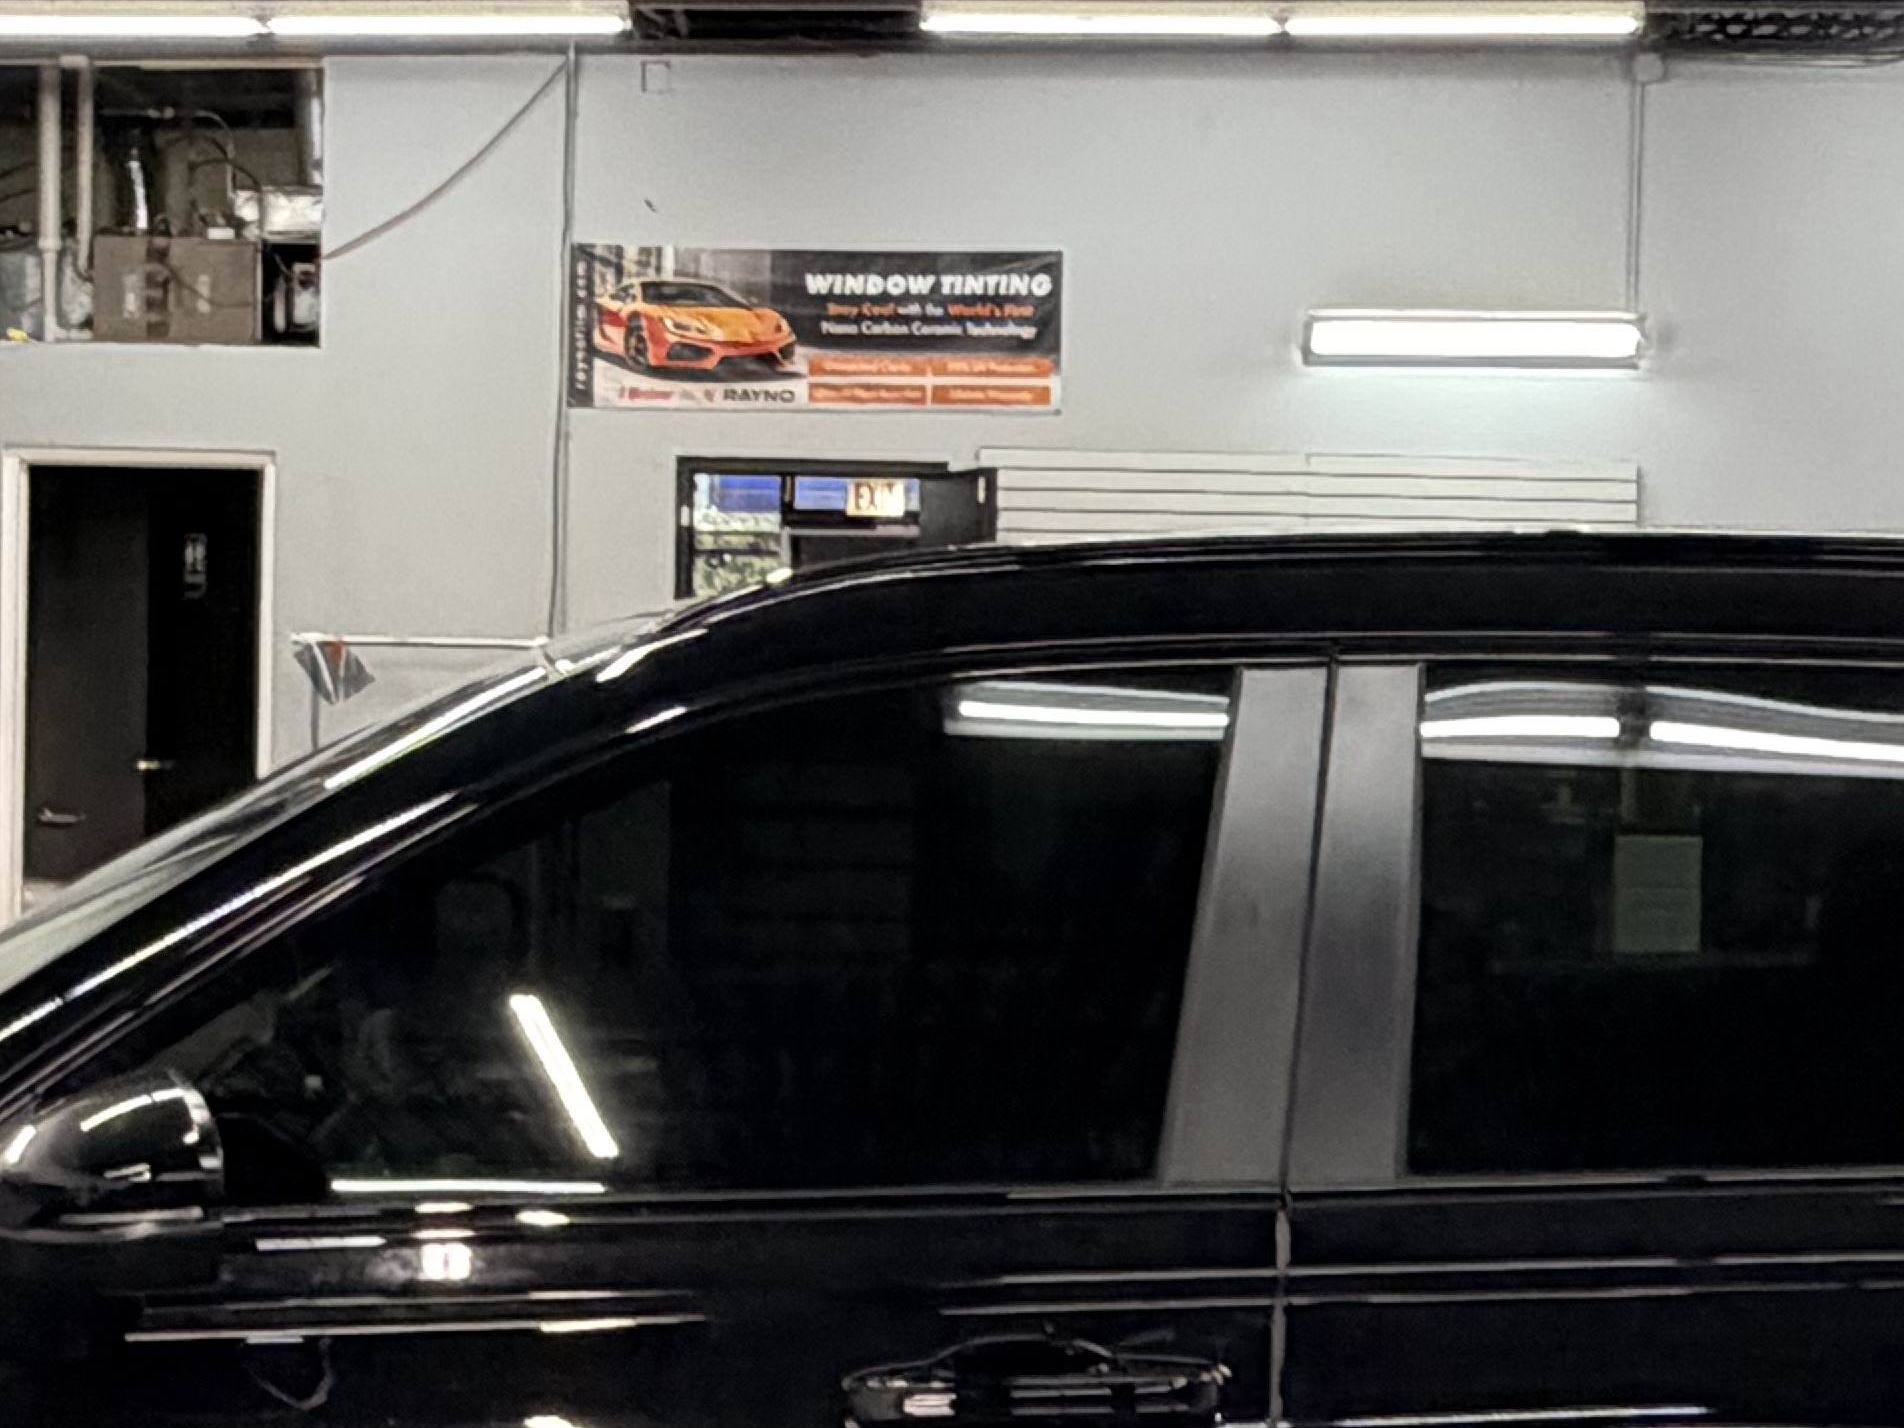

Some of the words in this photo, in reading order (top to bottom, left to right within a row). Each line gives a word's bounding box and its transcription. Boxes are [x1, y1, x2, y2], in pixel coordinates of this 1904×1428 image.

[805, 272, 936, 295] WINDOW
[940, 272, 1053, 297] TINTING
[722, 387, 796, 404] RAYNO
